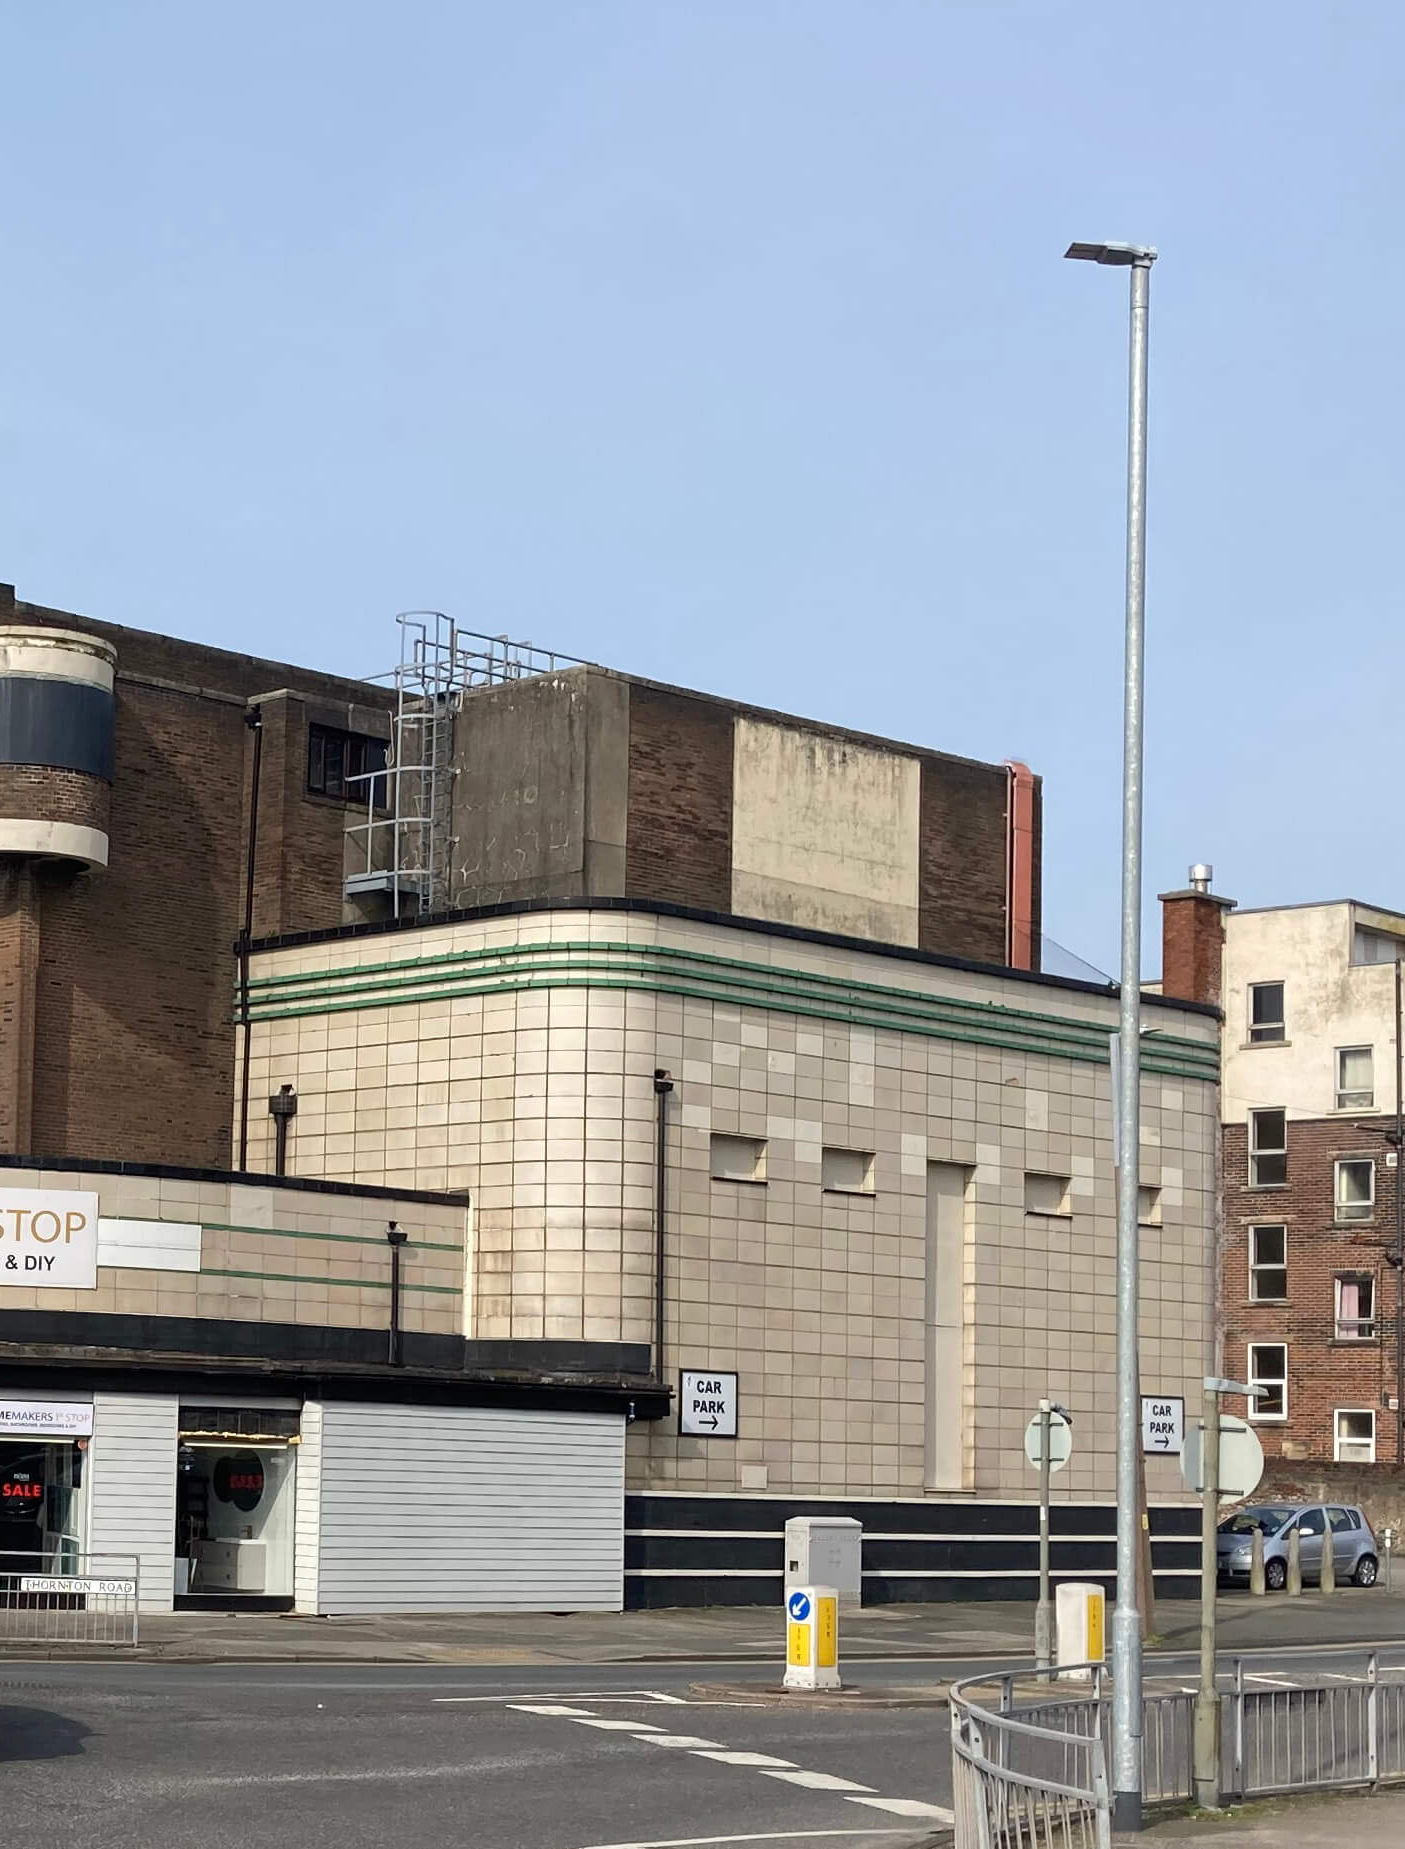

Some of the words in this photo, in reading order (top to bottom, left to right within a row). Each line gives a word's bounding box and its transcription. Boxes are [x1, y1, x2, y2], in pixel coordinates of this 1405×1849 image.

[5, 1254, 18, 1270] &
[24, 1255, 55, 1272] DIY
[696, 1380, 722, 1394] CAR
[693, 1400, 725, 1414] PARK
[1152, 1404, 1172, 1417] CAR
[65, 1412, 91, 1424] STOP
[1149, 1421, 1174, 1434] PARK
[2, 1483, 42, 1497] SALE
[26, 1579, 91, 1591] THORNTON
[99, 1582, 133, 1593] ROAD
